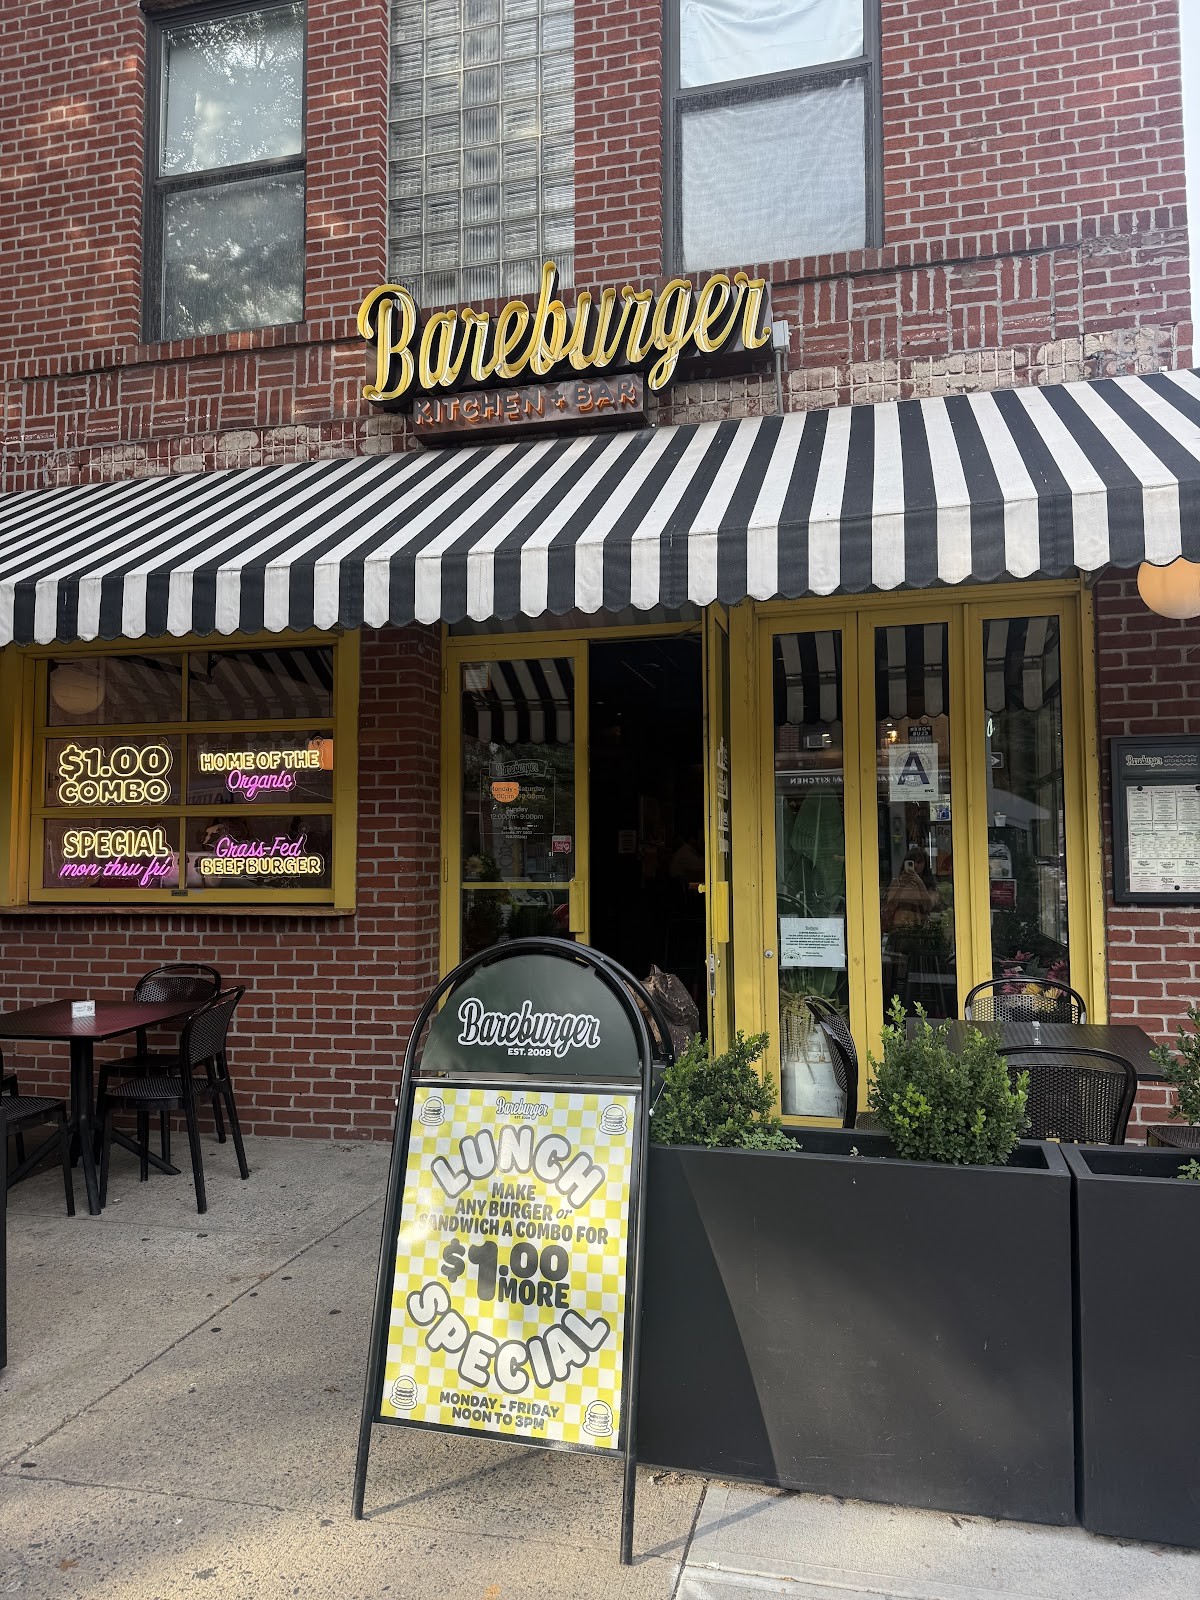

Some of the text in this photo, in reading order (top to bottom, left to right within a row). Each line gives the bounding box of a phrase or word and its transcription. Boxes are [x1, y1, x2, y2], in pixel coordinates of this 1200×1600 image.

[357, 261, 771, 401] Bareburger
[413, 388, 546, 425] KITCHEN
[574, 378, 638, 410] BAR
[59, 744, 170, 781] $1.00
[200, 750, 320, 771] HOME OF THE
[897, 751, 930, 785] A
[59, 779, 169, 803] COMBO
[227, 770, 293, 798] Organic
[63, 829, 168, 858] SPECIAL
[215, 836, 303, 858] Grass-Fed
[59, 857, 171, 886] mon thru fri
[201, 856, 321, 874] BEEF BURGER
[457, 997, 601, 1058] Bareburger
[508, 1048, 551, 1057] EST. 2009
[496, 1095, 548, 1120] Bareburger
[431, 1125, 605, 1209] LUNCH
[491, 1182, 536, 1201] MAKE
[455, 1198, 572, 1222] ANY BURGER or
[502, 1221, 513, 1237] A
[516, 1221, 573, 1242] COMBO
[576, 1226, 609, 1245] FOR
[440, 1238, 570, 1302] $1.00
[498, 1276, 570, 1309] MORE
[407, 1281, 610, 1394] SPECIAL
[439, 1391, 498, 1410] MONDAY
[508, 1400, 560, 1418] FRIDAY
[452, 1407, 545, 1430] NOON TO 3PM
